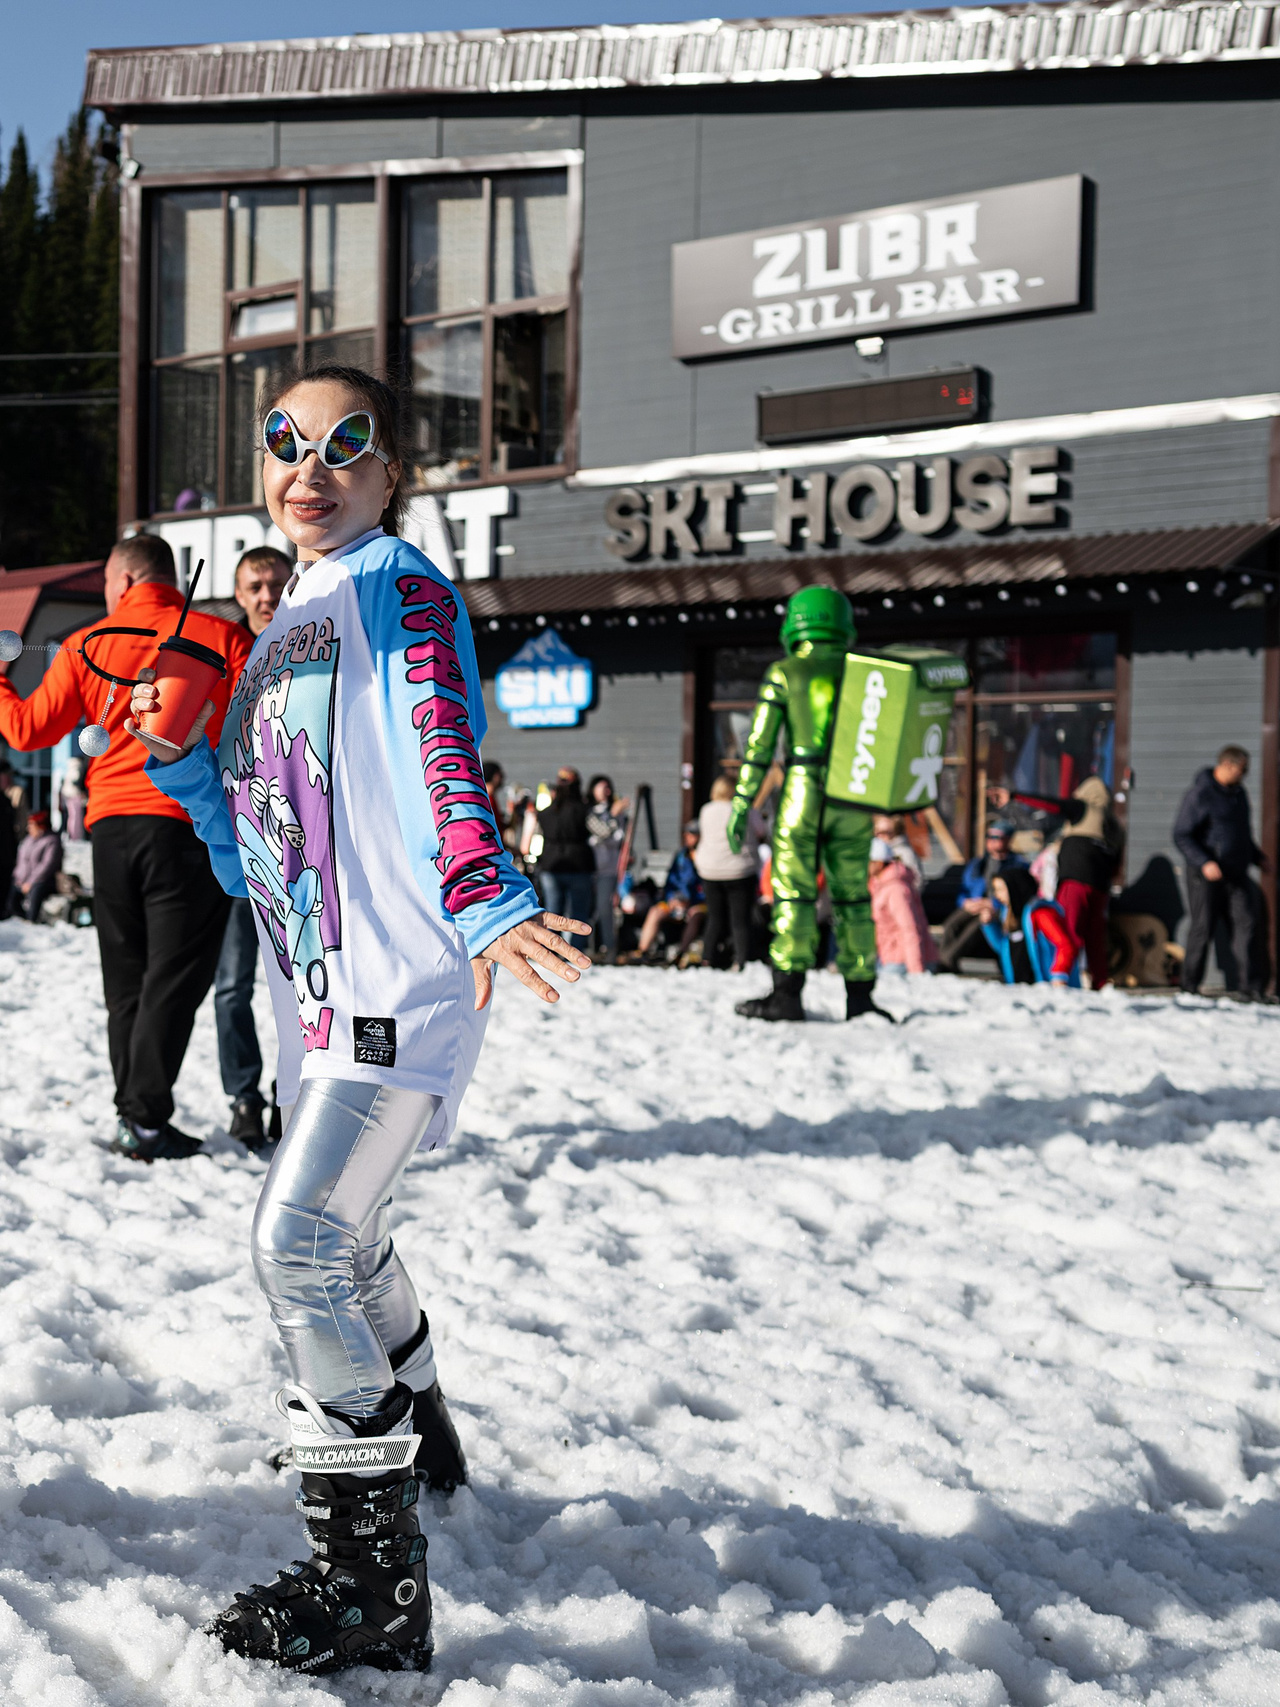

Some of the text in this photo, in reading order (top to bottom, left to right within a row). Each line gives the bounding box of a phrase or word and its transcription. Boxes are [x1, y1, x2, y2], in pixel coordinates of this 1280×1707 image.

[753, 202, 980, 298] ZUBR
[604, 446, 1062, 559] SKI HOUSE
[275, 617, 334, 670] FOR
[500, 664, 587, 709] SKI
[848, 670, 888, 794] купер
[296, 1447, 386, 1464] SALOMON
[351, 1512, 397, 1530] SELECT
